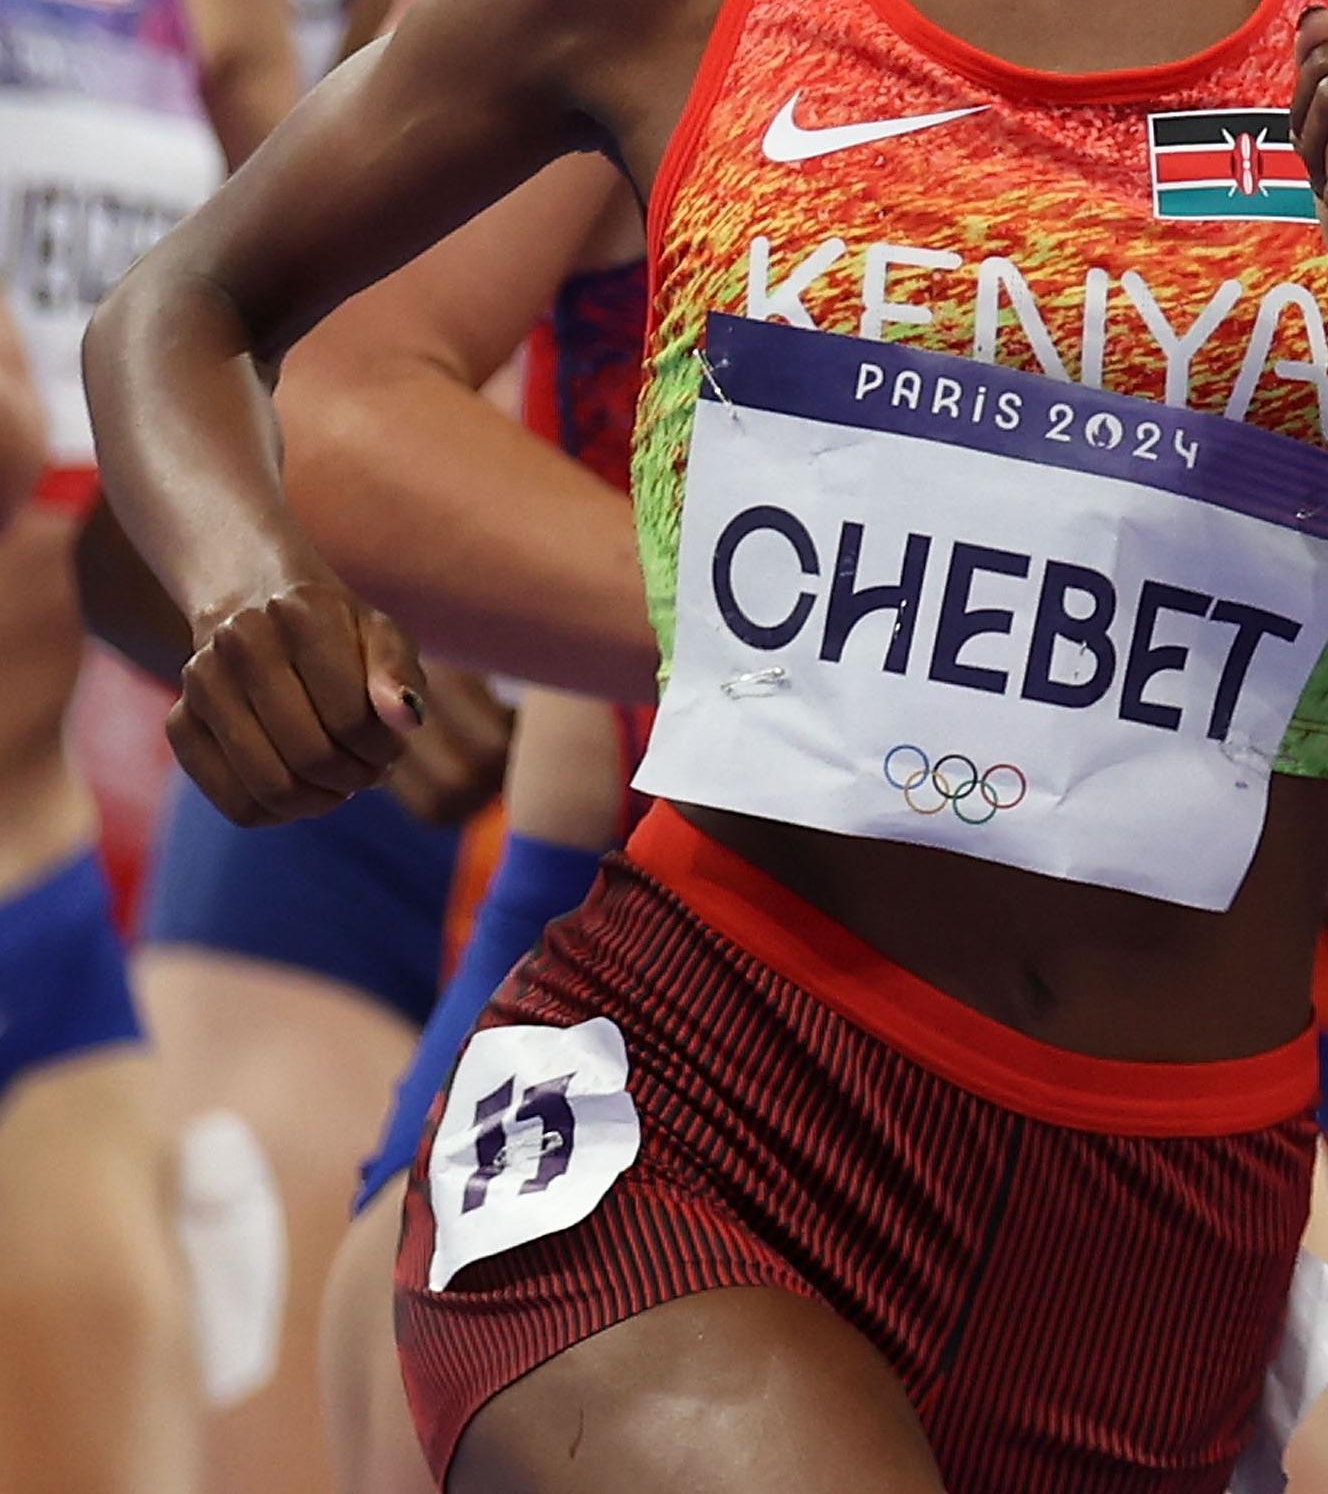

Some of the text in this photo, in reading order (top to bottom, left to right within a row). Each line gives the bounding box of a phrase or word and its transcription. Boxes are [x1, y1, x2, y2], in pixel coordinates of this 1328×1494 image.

[854, 362, 1200, 469] PARIS 2024
[711, 504, 1301, 742] CHEBET
